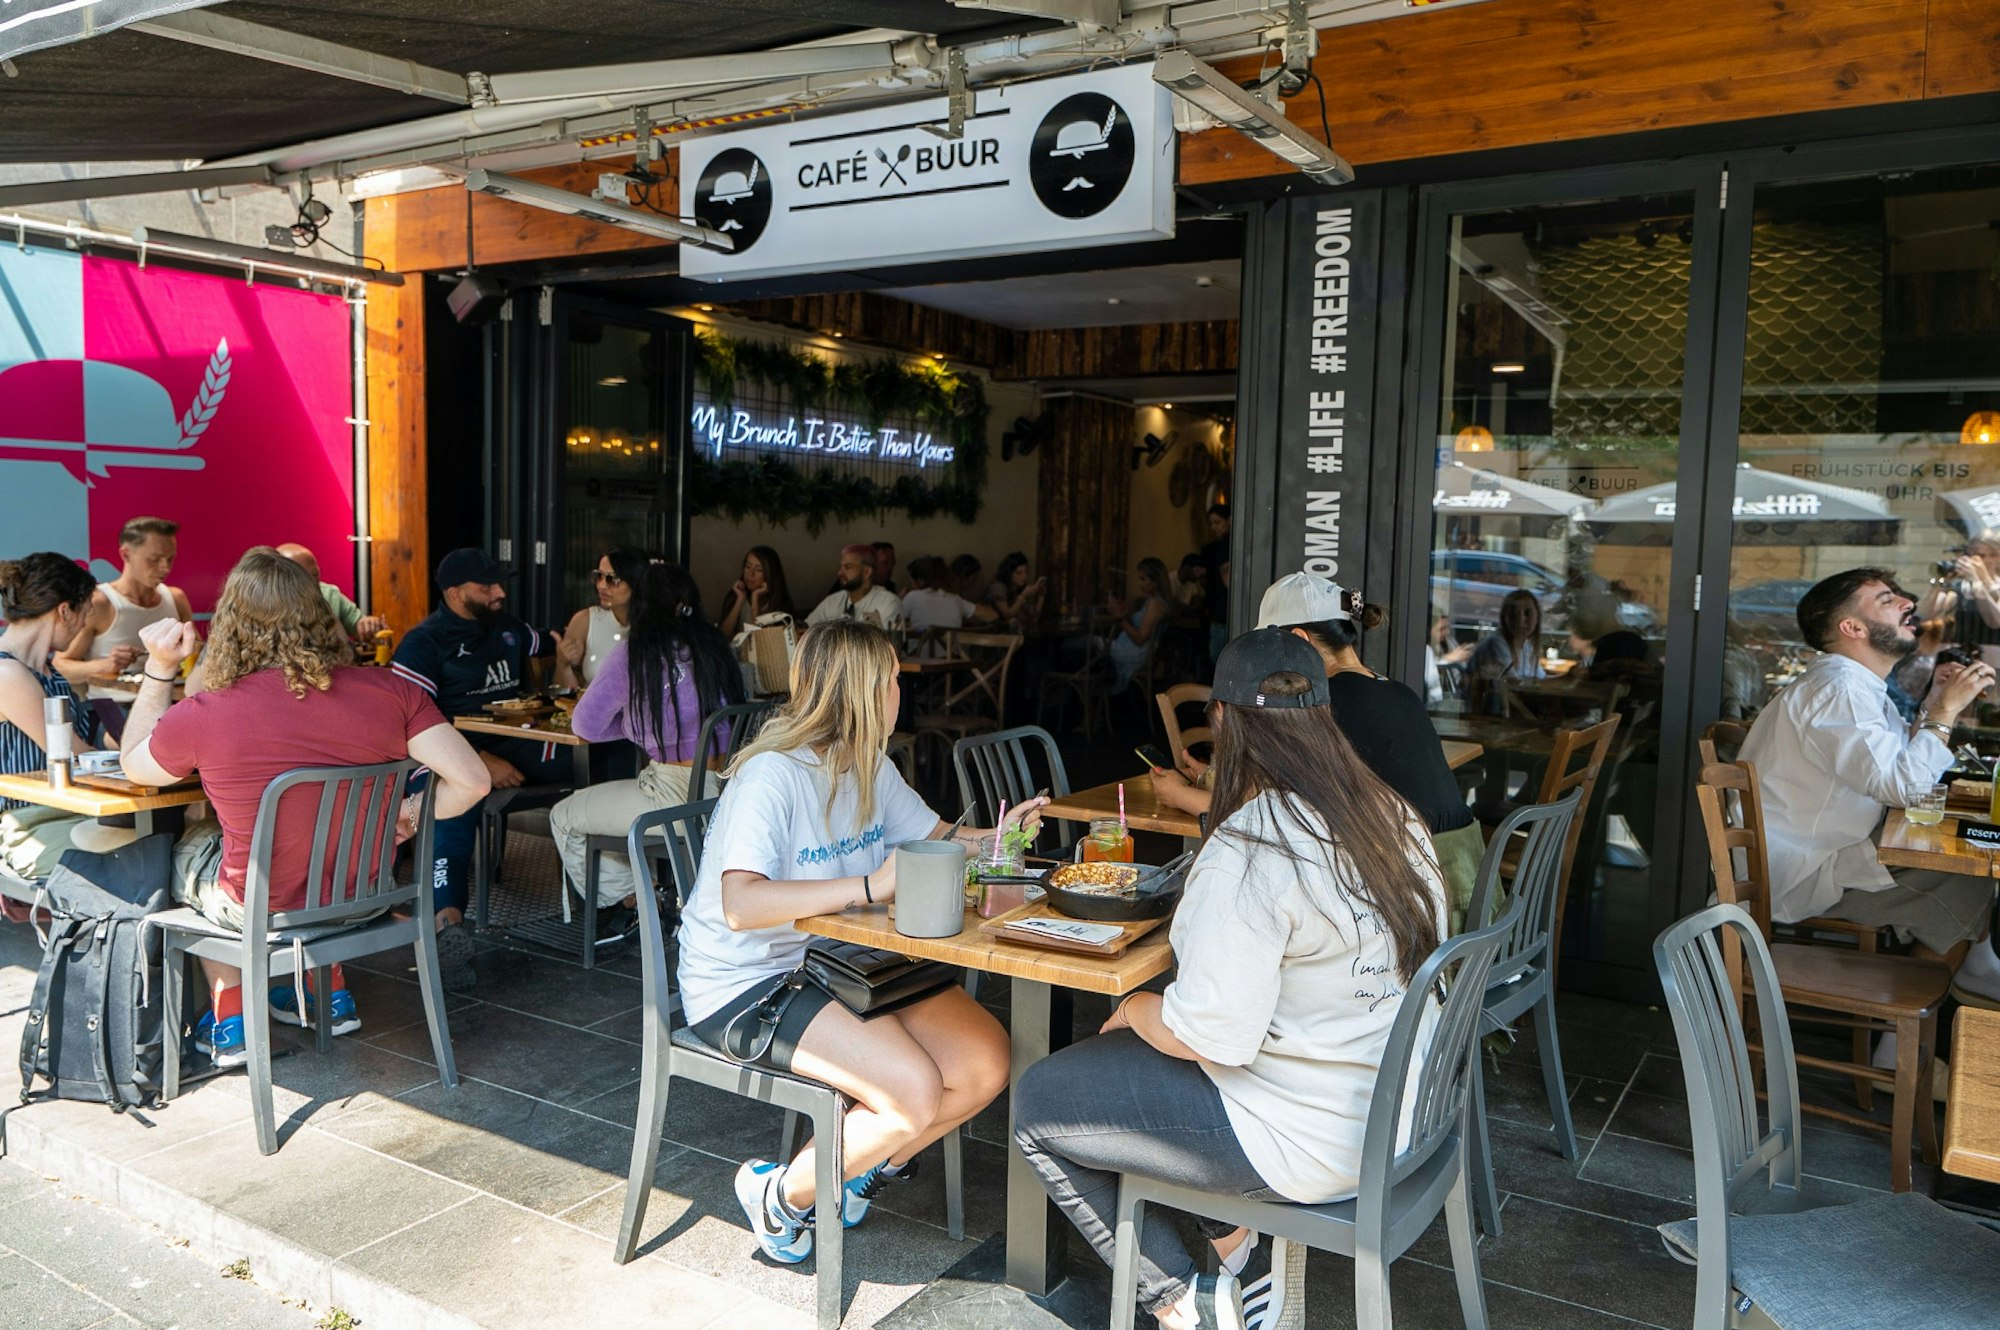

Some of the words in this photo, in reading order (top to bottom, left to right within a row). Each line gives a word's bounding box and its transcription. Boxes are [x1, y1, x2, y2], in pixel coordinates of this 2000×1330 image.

[798, 150, 868, 189] CAFÉ
[916, 138, 1000, 175] BUUR
[1310, 208, 1352, 374] #FREEDOM
[691, 405, 725, 457] My
[727, 410, 797, 449] Brunch
[799, 418, 825, 449] Is
[825, 422, 877, 454] Better
[878, 428, 912, 457] Than
[913, 432, 954, 468] Yours
[1306, 390, 1345, 473] #LIFE
[1589, 478, 1638, 491] BUUR
[1791, 459, 1925, 478] FRÜHSTÜCK
[1933, 463, 1970, 478] BIS
[1886, 485, 1933, 500] UHR
[1303, 491, 1341, 579] OMAN
[1966, 827, 2000, 840] reserv
[433, 857, 449, 889] PARIS
